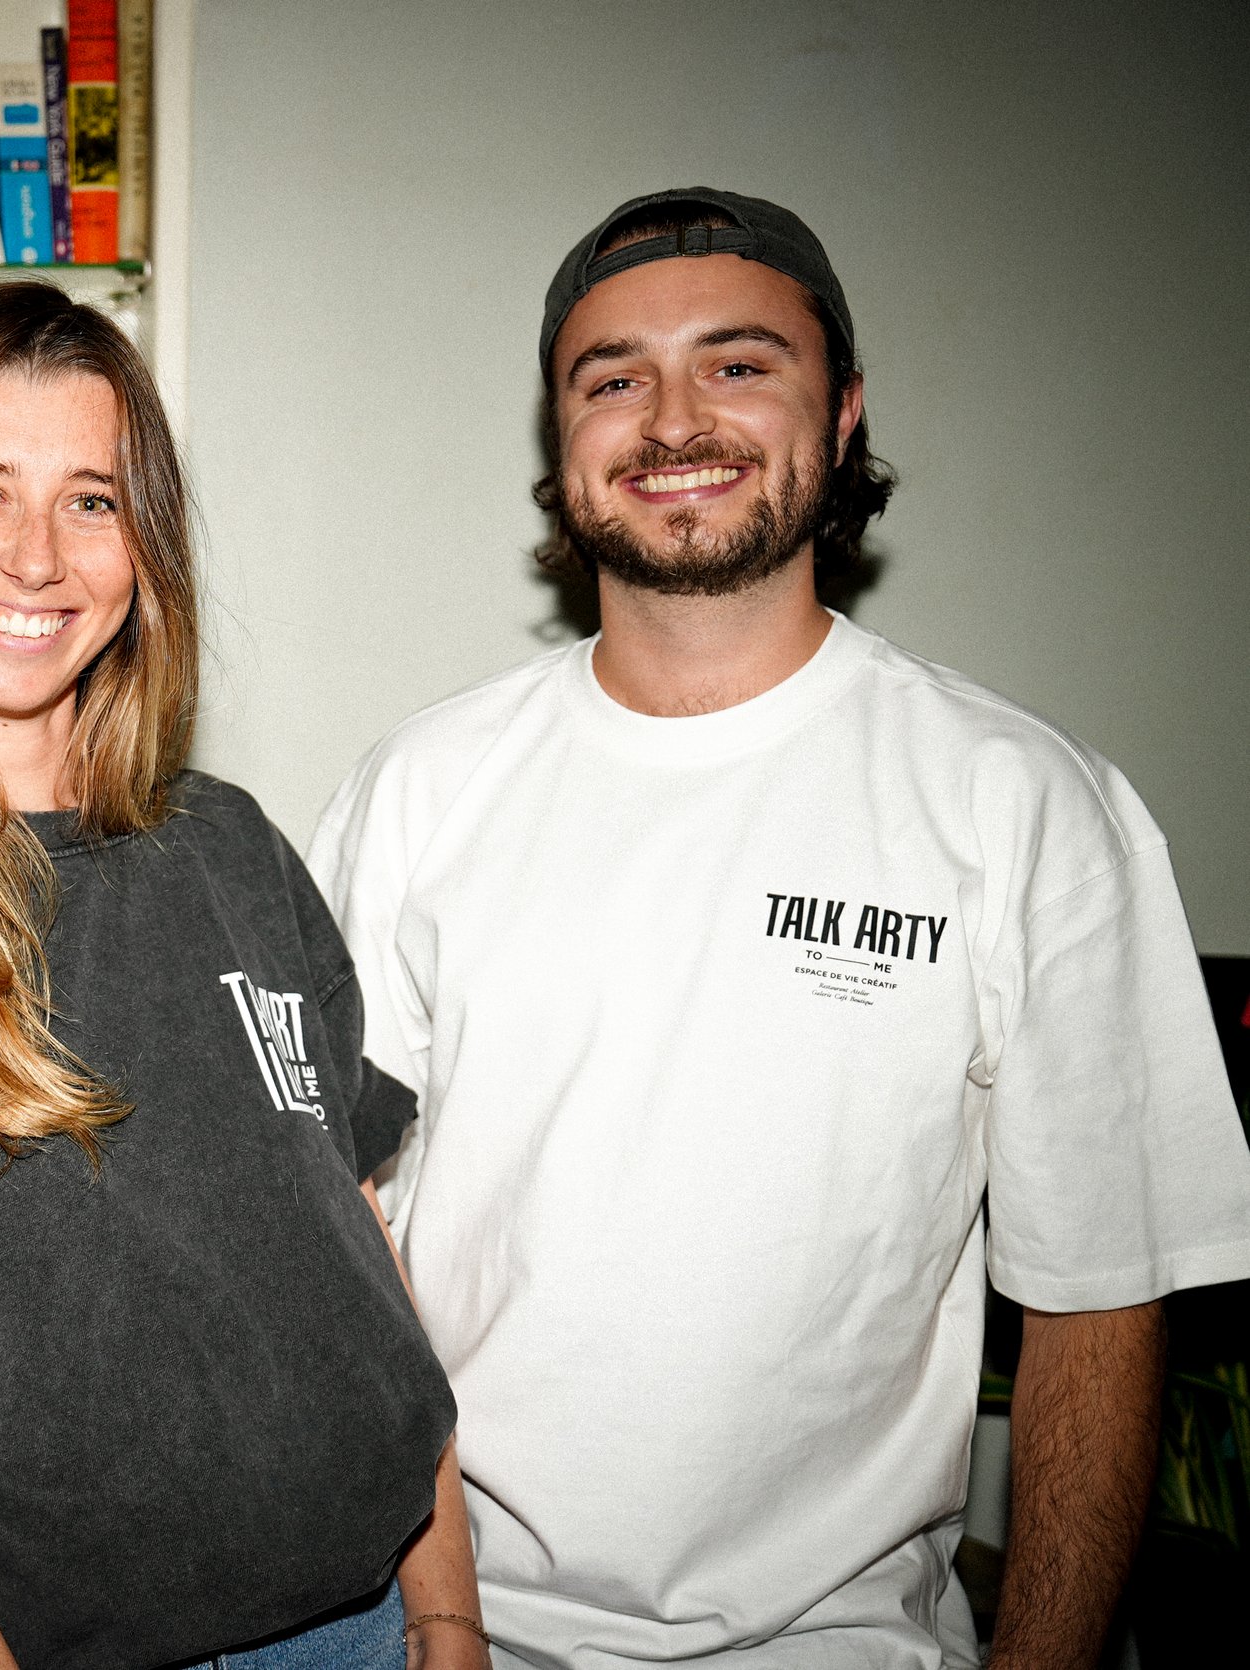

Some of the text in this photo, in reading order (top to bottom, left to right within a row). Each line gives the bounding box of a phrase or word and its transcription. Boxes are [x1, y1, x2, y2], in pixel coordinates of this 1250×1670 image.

[766, 893, 948, 963] TALK ARTY
[806, 949, 892, 974] TO ME
[794, 966, 898, 990] ESPACE DE VIE CRÉATIF
[818, 982, 870, 996] Restaurant Atelier
[300, 1065, 321, 1097] ME
